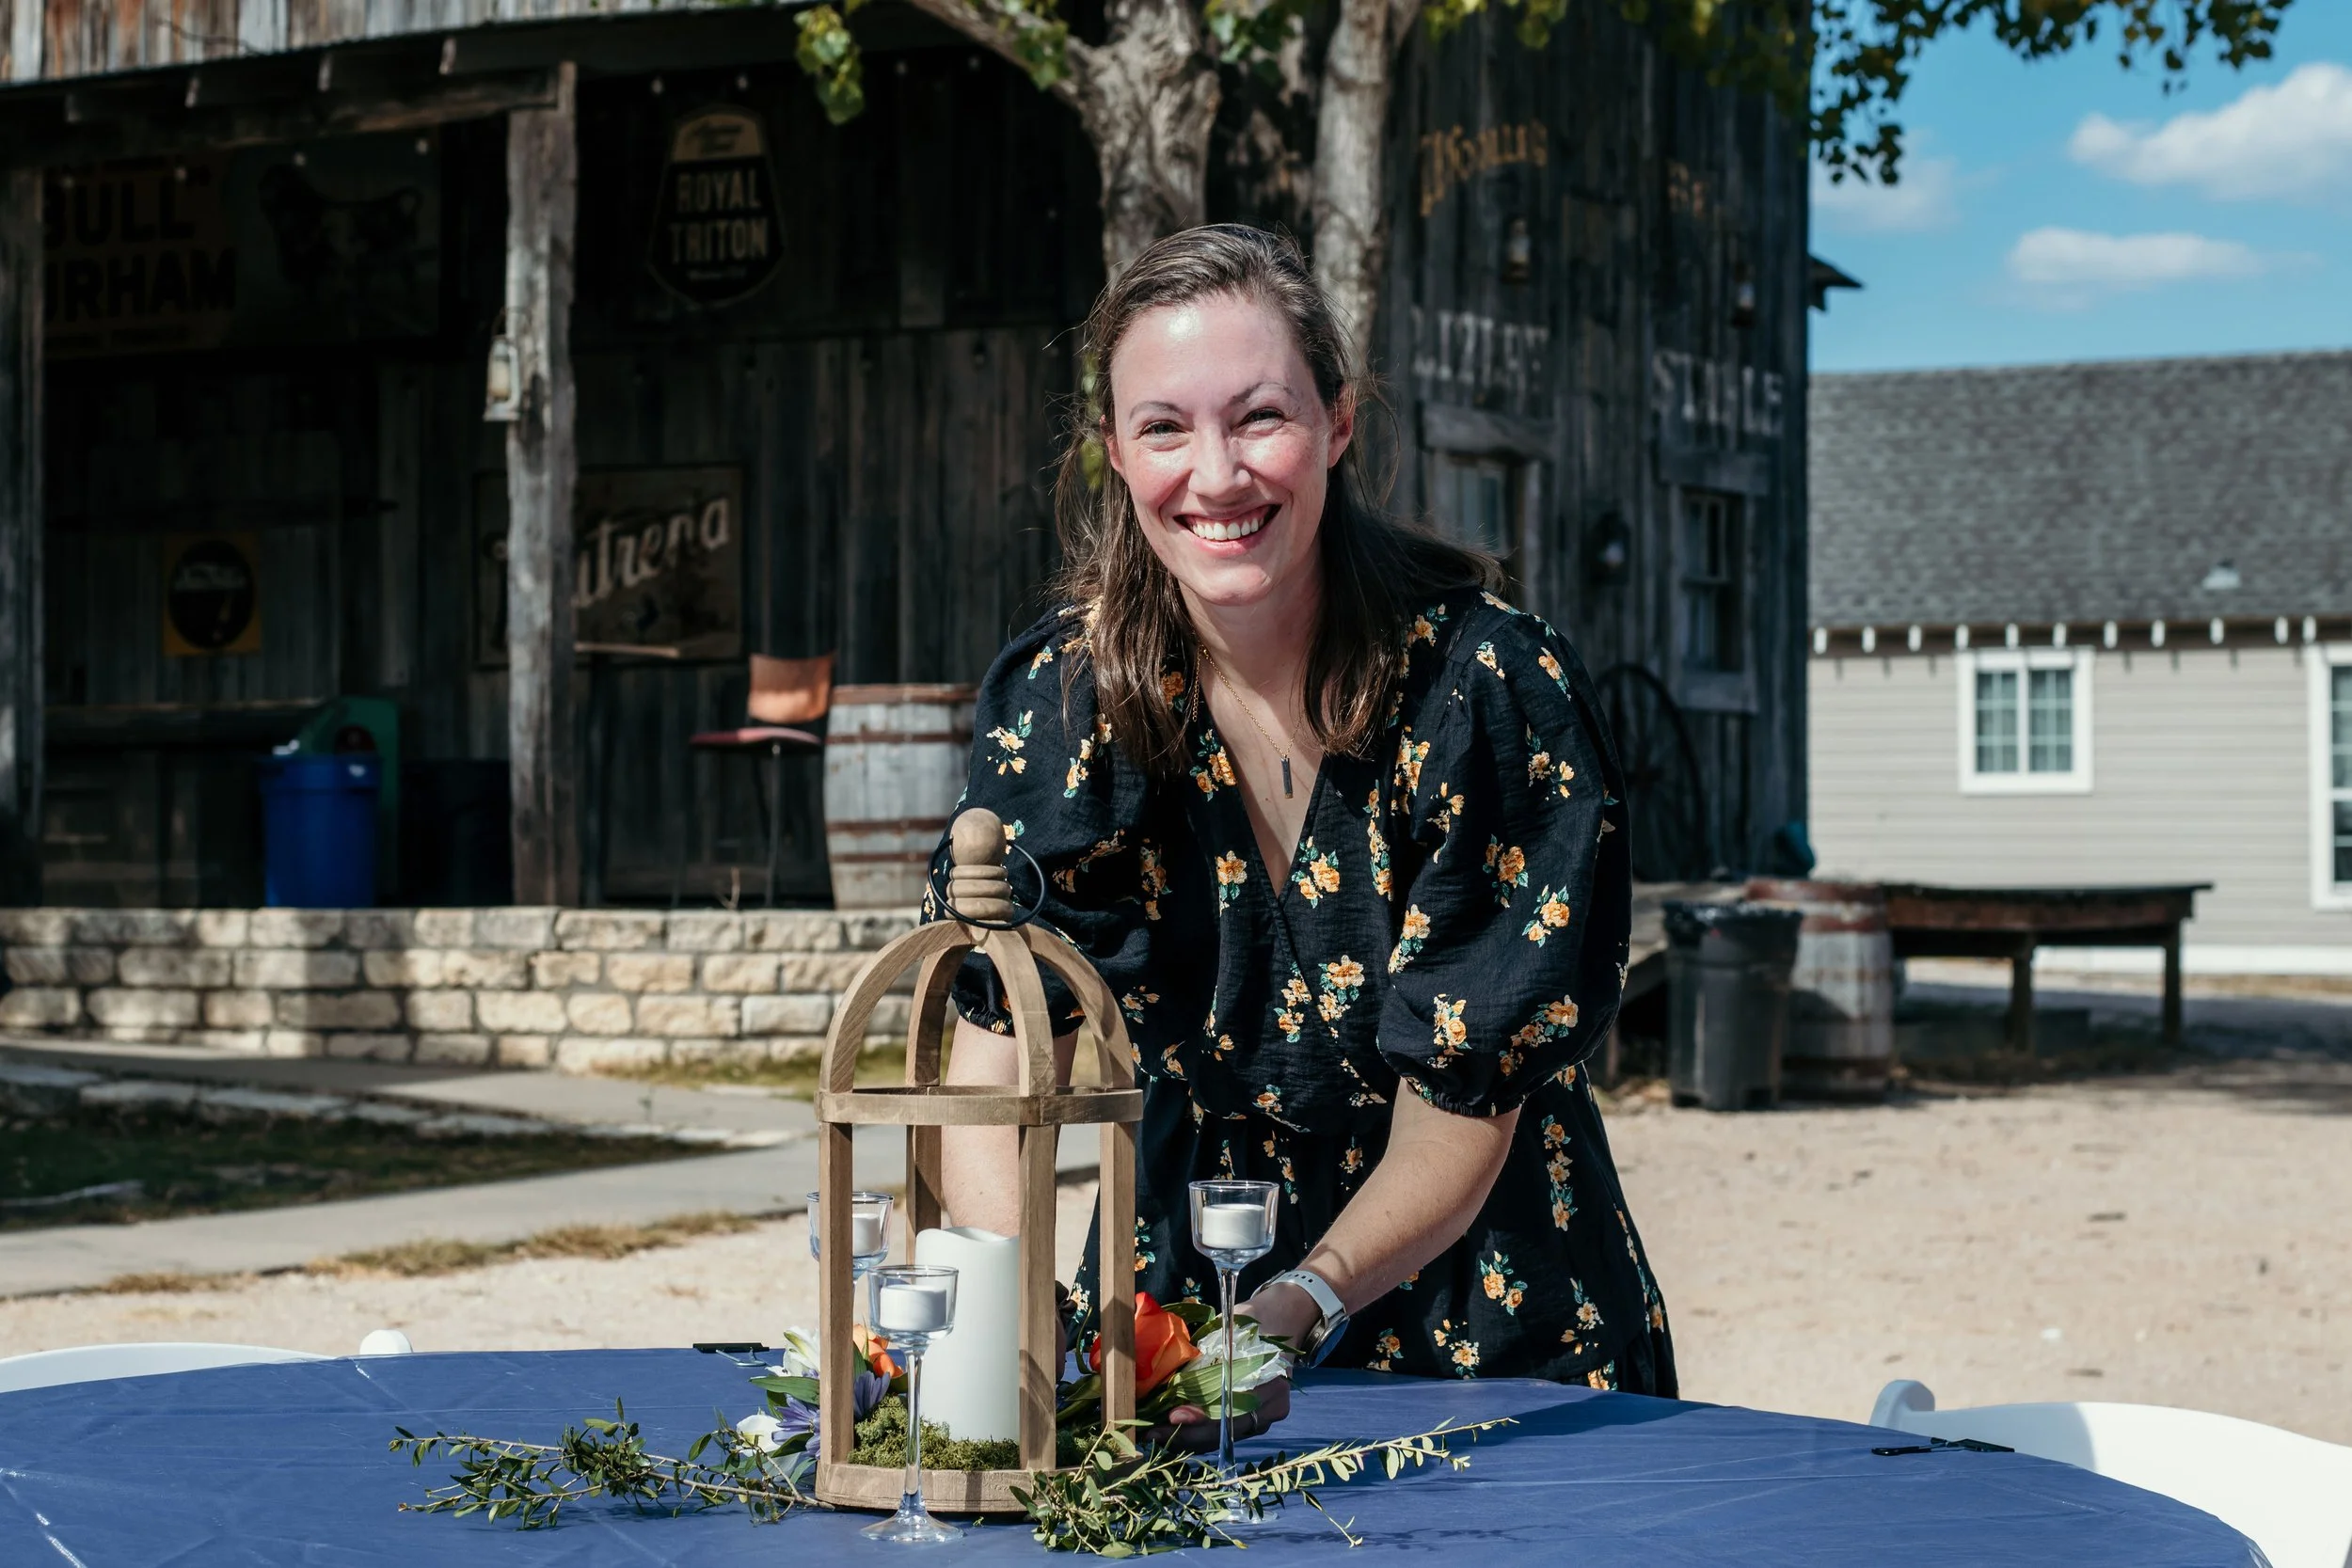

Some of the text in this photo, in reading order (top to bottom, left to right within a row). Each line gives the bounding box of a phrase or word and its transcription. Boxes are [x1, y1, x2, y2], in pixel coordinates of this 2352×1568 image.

[675, 166, 764, 214] ROYAL
[667, 215, 771, 266] TRITON
[45, 246, 237, 323] RHAM
